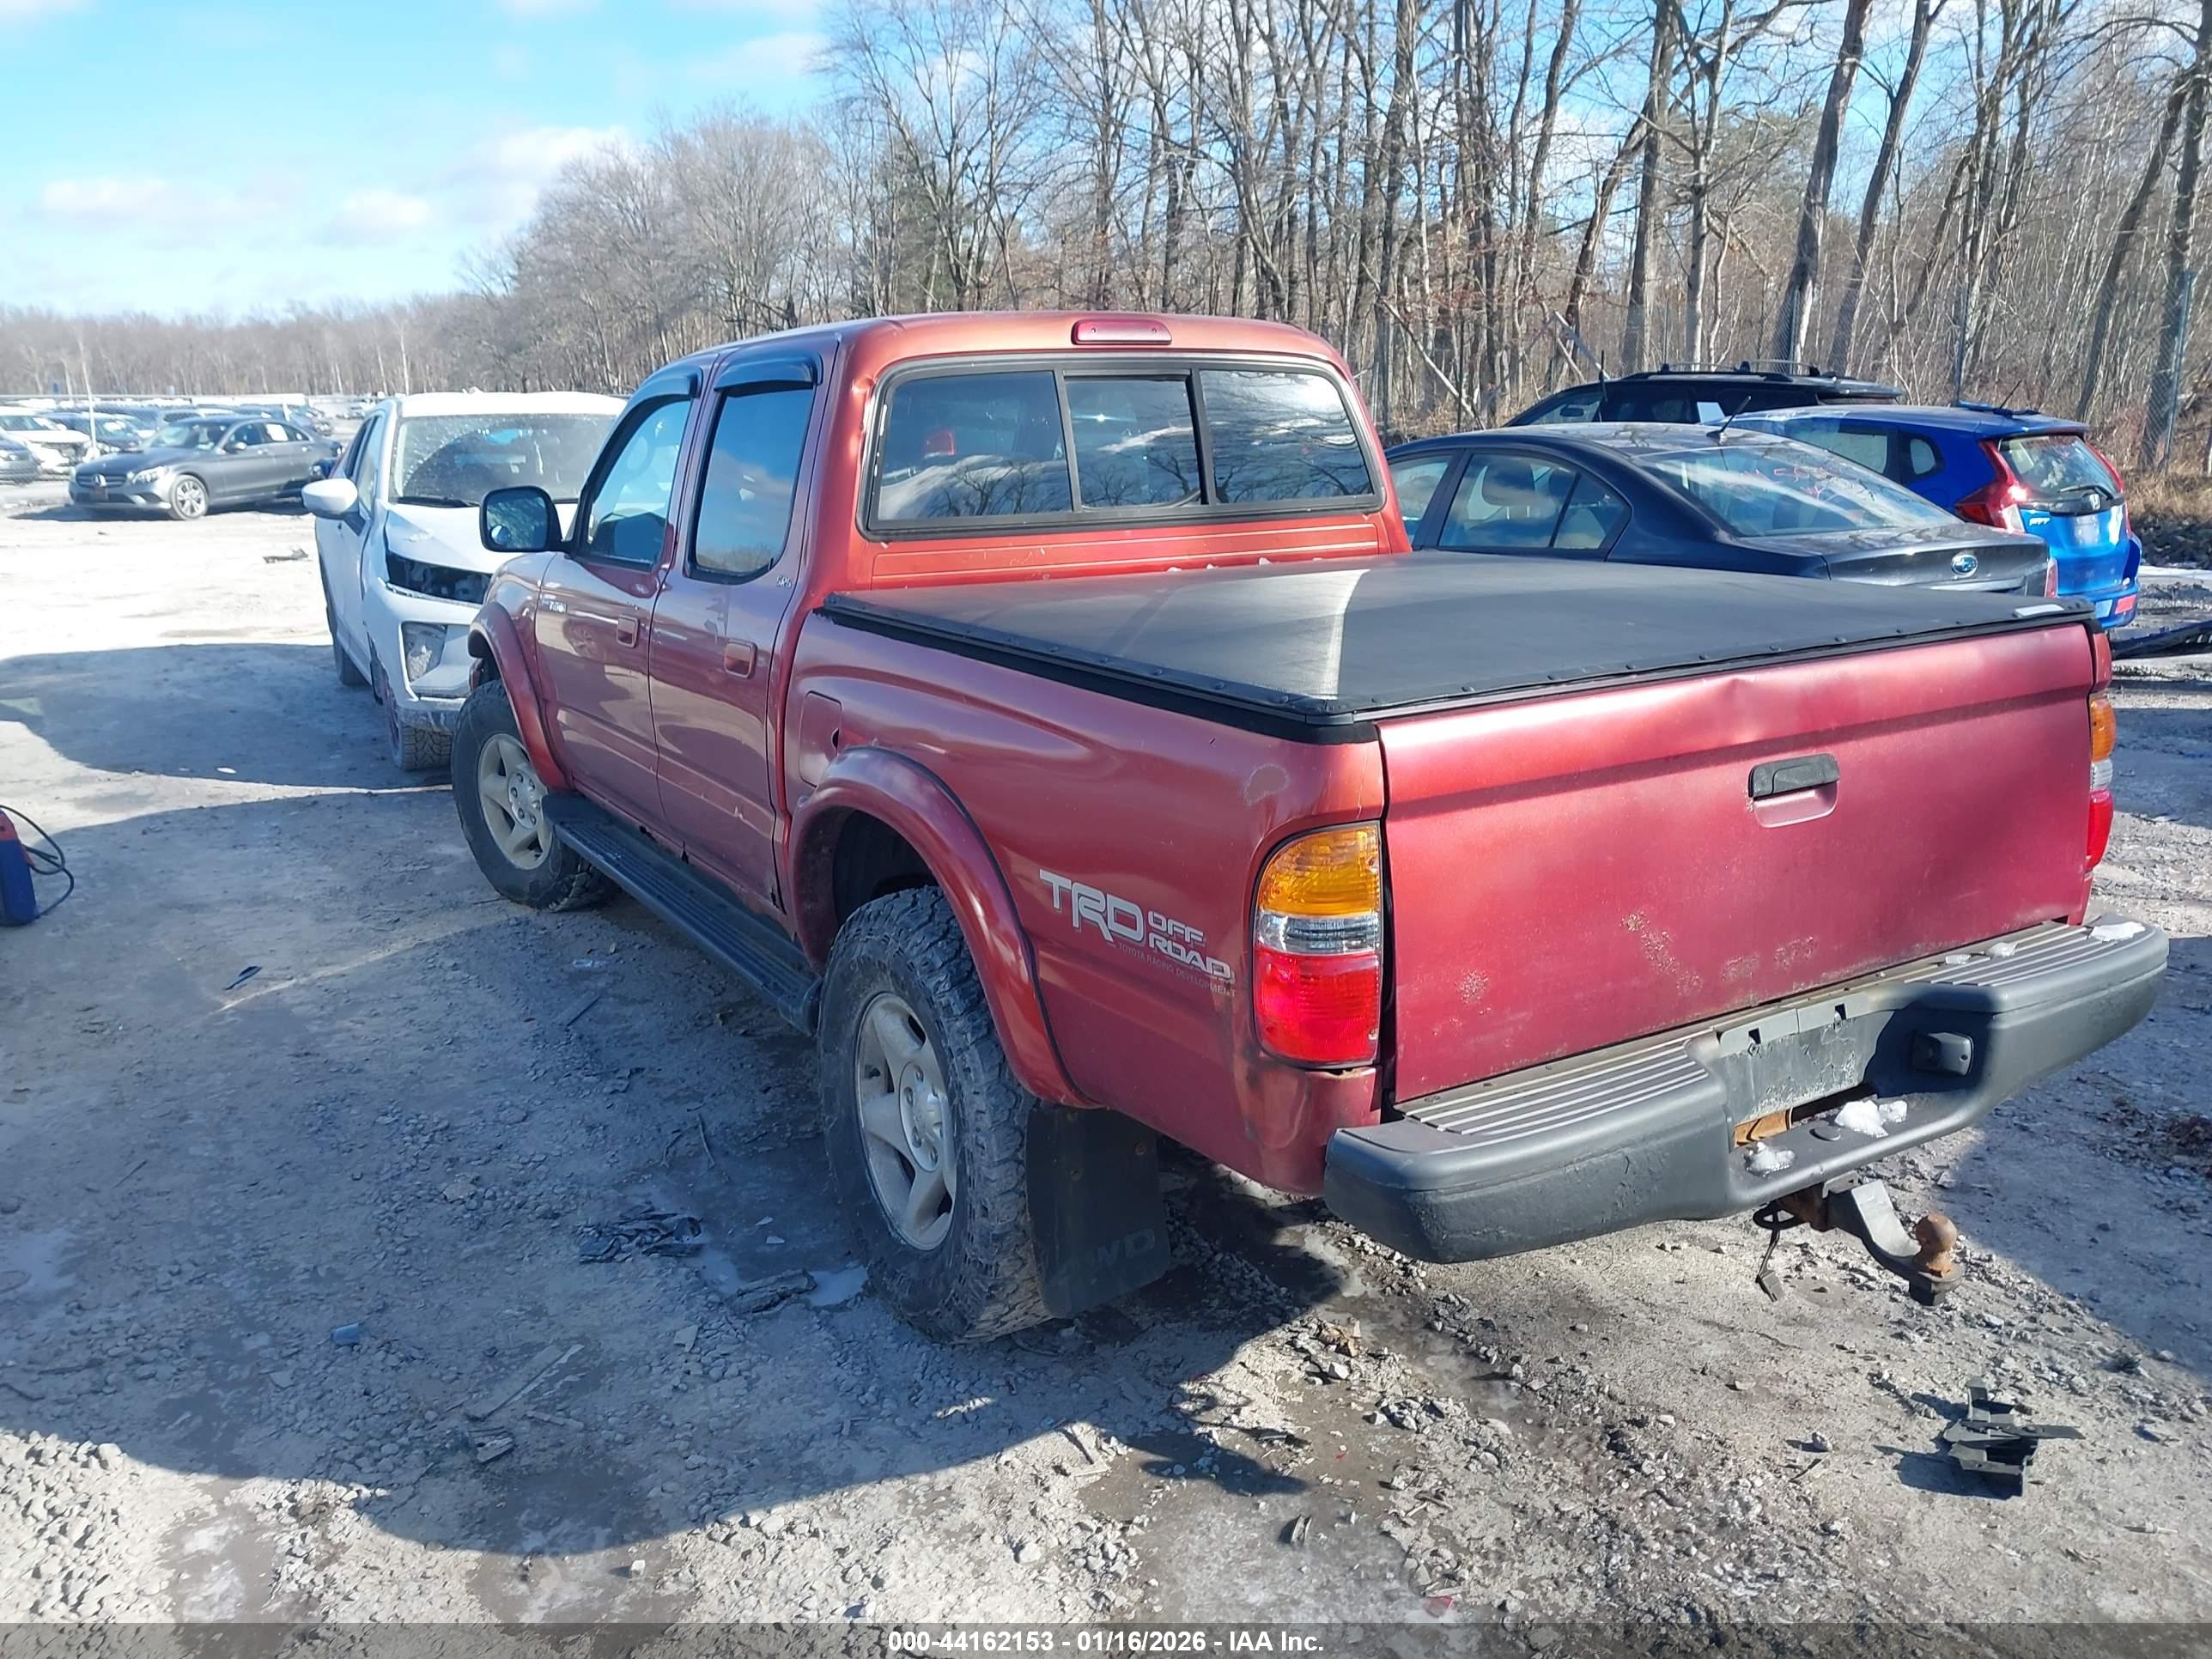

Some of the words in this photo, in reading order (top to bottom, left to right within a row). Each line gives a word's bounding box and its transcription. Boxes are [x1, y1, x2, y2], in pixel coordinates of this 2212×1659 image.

[1039, 868, 1145, 944] TRD
[1148, 910, 1205, 944] OFF
[1118, 943, 1145, 960] TOYOTA
[1149, 933, 1234, 981] ROAD
